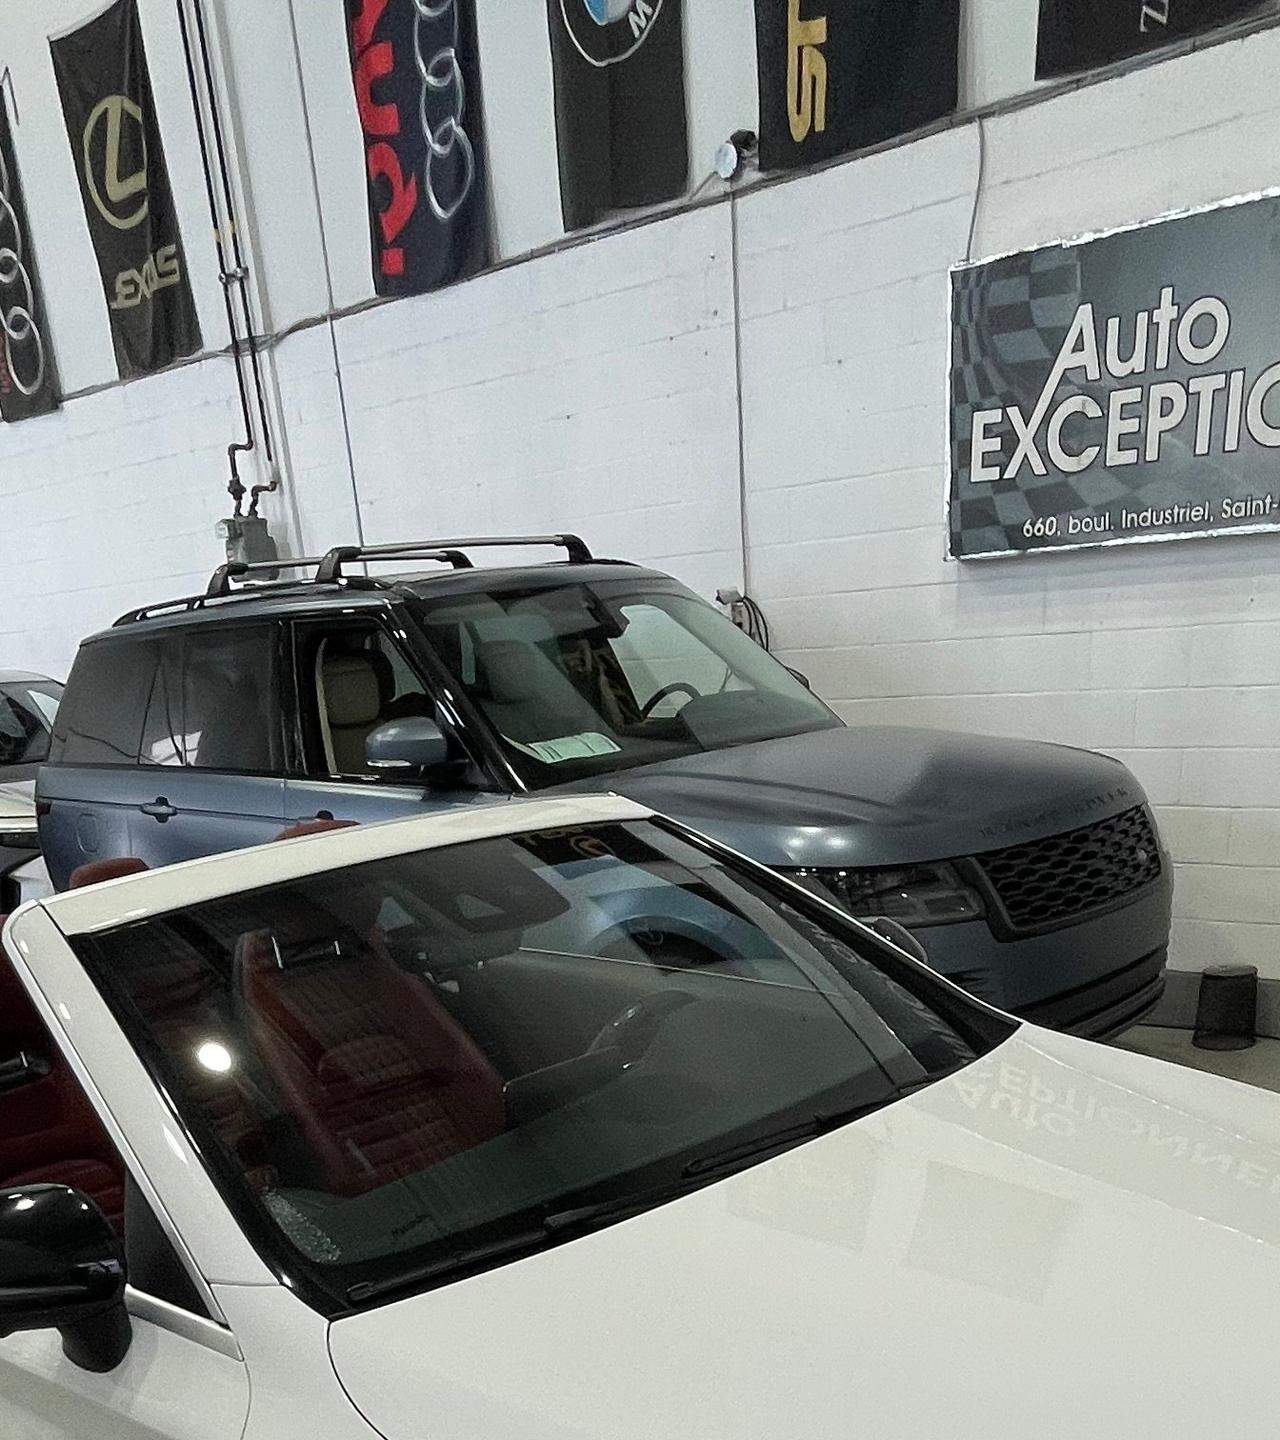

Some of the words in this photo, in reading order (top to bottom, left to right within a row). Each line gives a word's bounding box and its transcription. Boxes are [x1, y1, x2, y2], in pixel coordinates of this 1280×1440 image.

[1050, 285, 1231, 384] Auto
[1022, 515, 1062, 538] 660,
[1068, 511, 1115, 534] boul.
[1122, 500, 1214, 530] Industriel,
